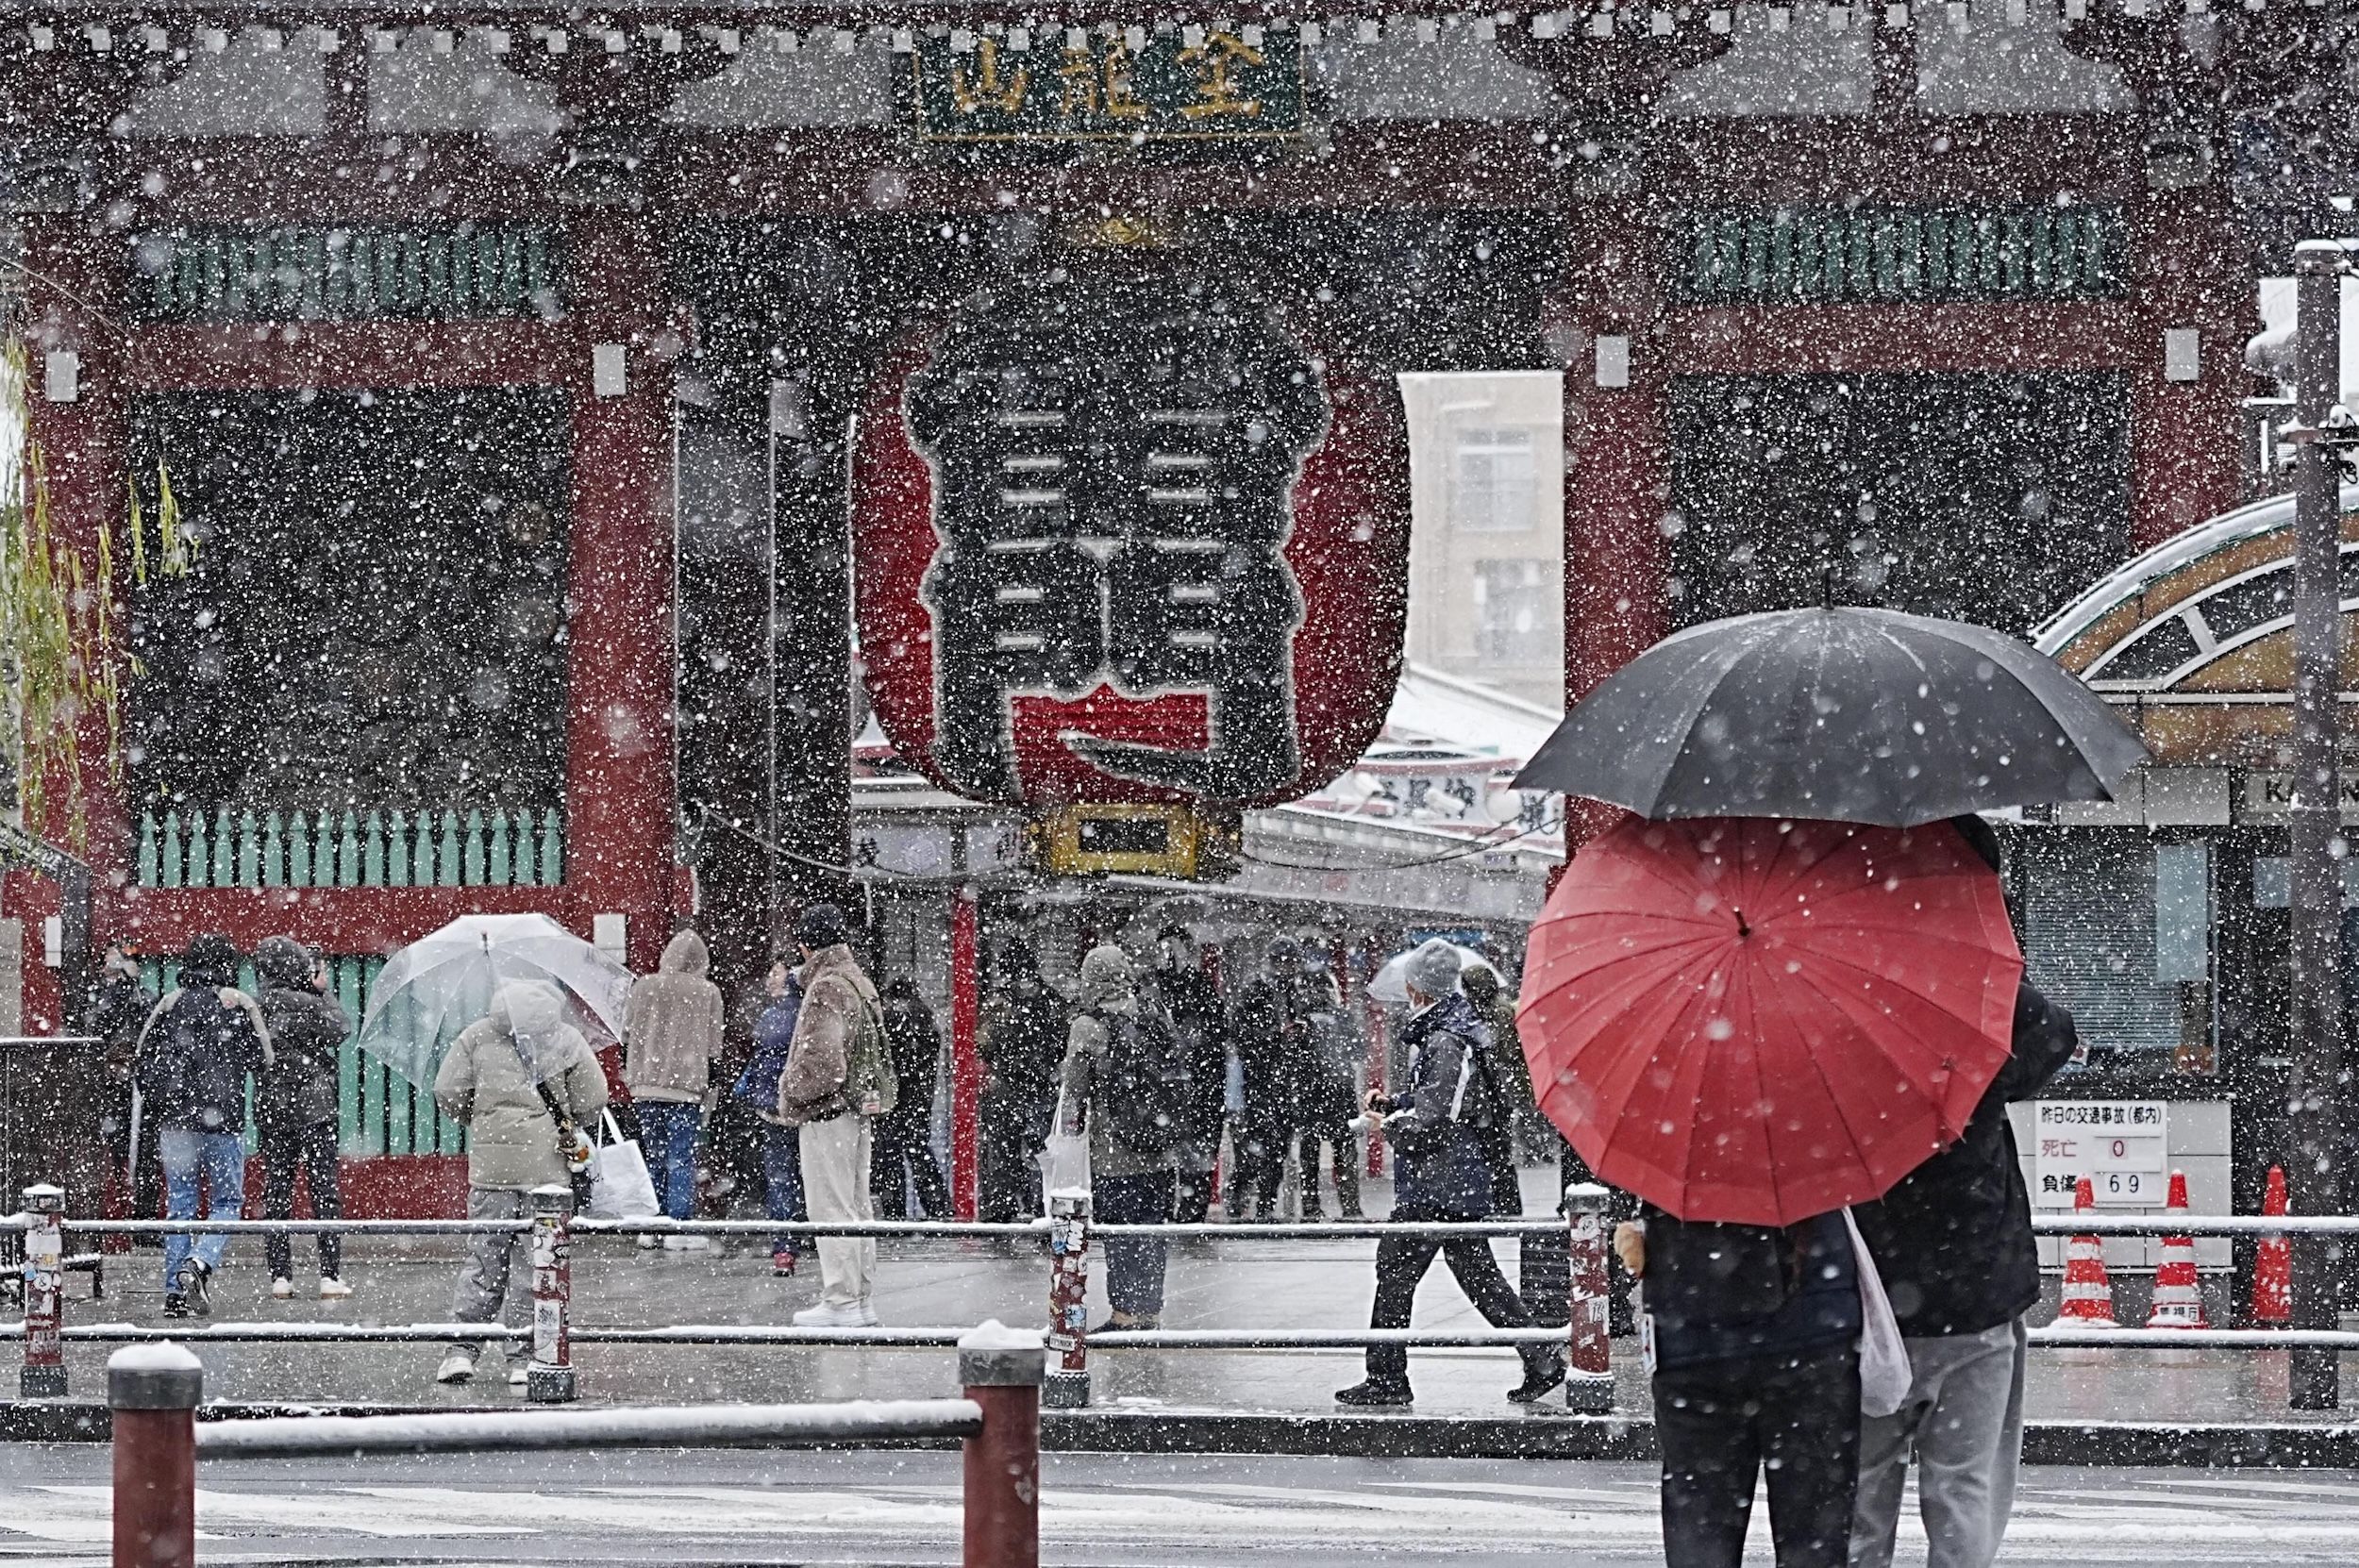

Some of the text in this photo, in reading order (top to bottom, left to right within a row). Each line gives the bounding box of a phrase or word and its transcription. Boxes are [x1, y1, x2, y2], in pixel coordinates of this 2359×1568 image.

[2041, 1139, 2124, 1158] 死亡 0
[2042, 1175, 2077, 1193] 負傷
